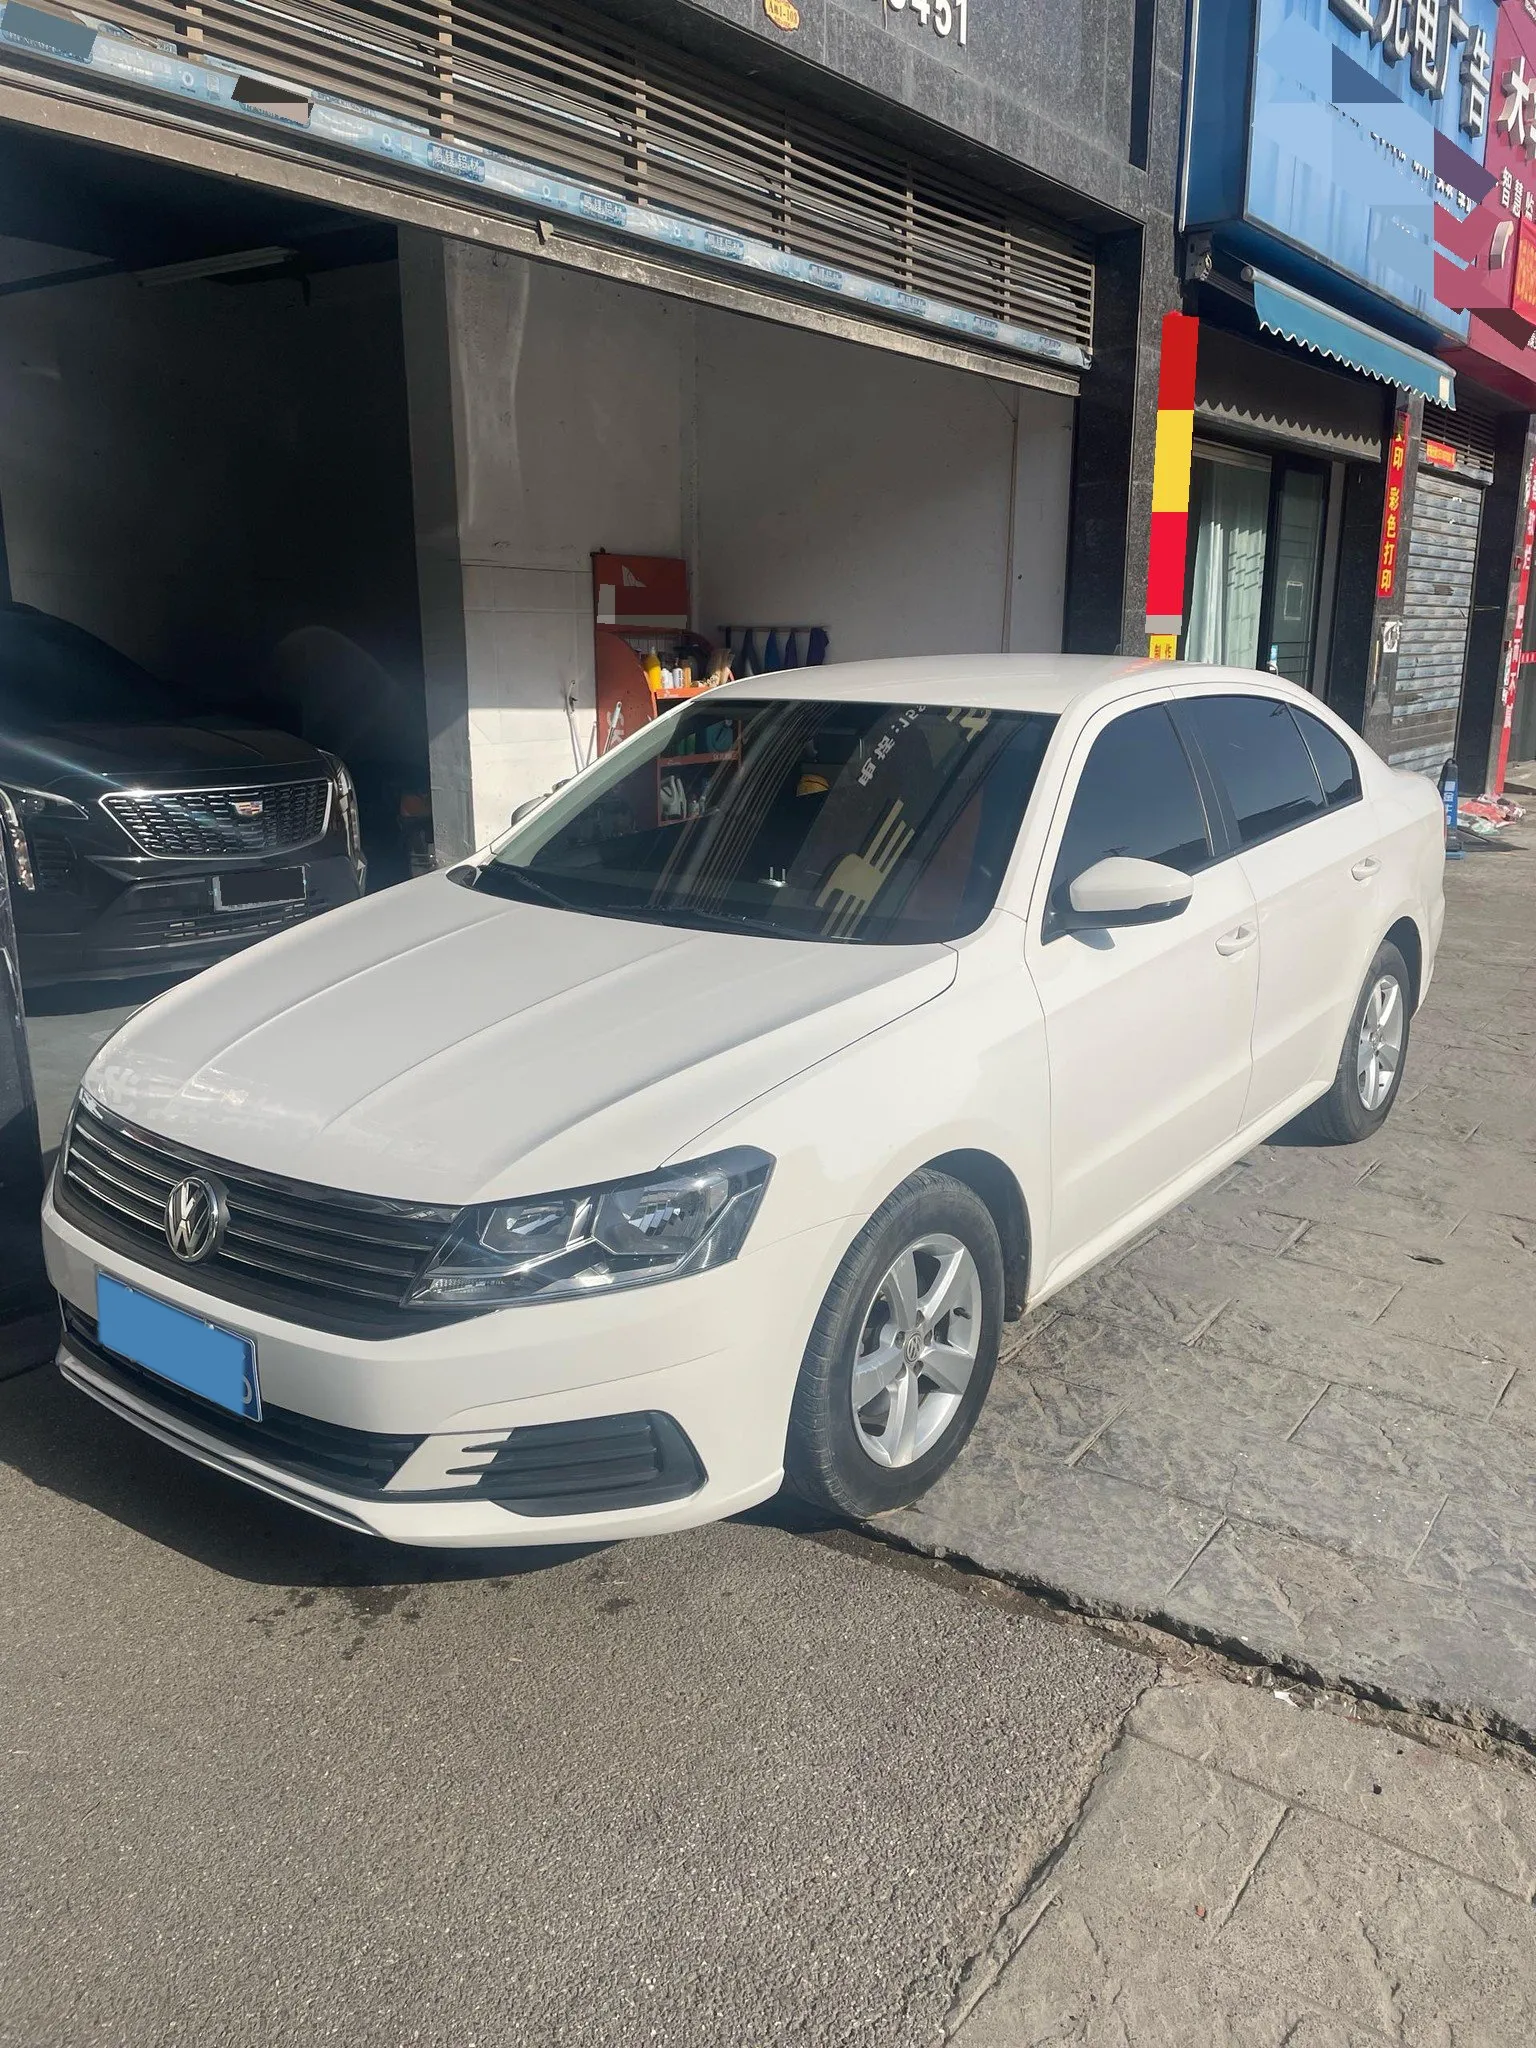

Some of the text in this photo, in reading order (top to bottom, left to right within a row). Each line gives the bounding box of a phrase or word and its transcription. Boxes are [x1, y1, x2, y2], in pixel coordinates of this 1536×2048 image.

[887, 0, 967, 45] 451
[1340, 0, 1490, 135] 电广告
[1381, 486, 1399, 593] 彩色打印
